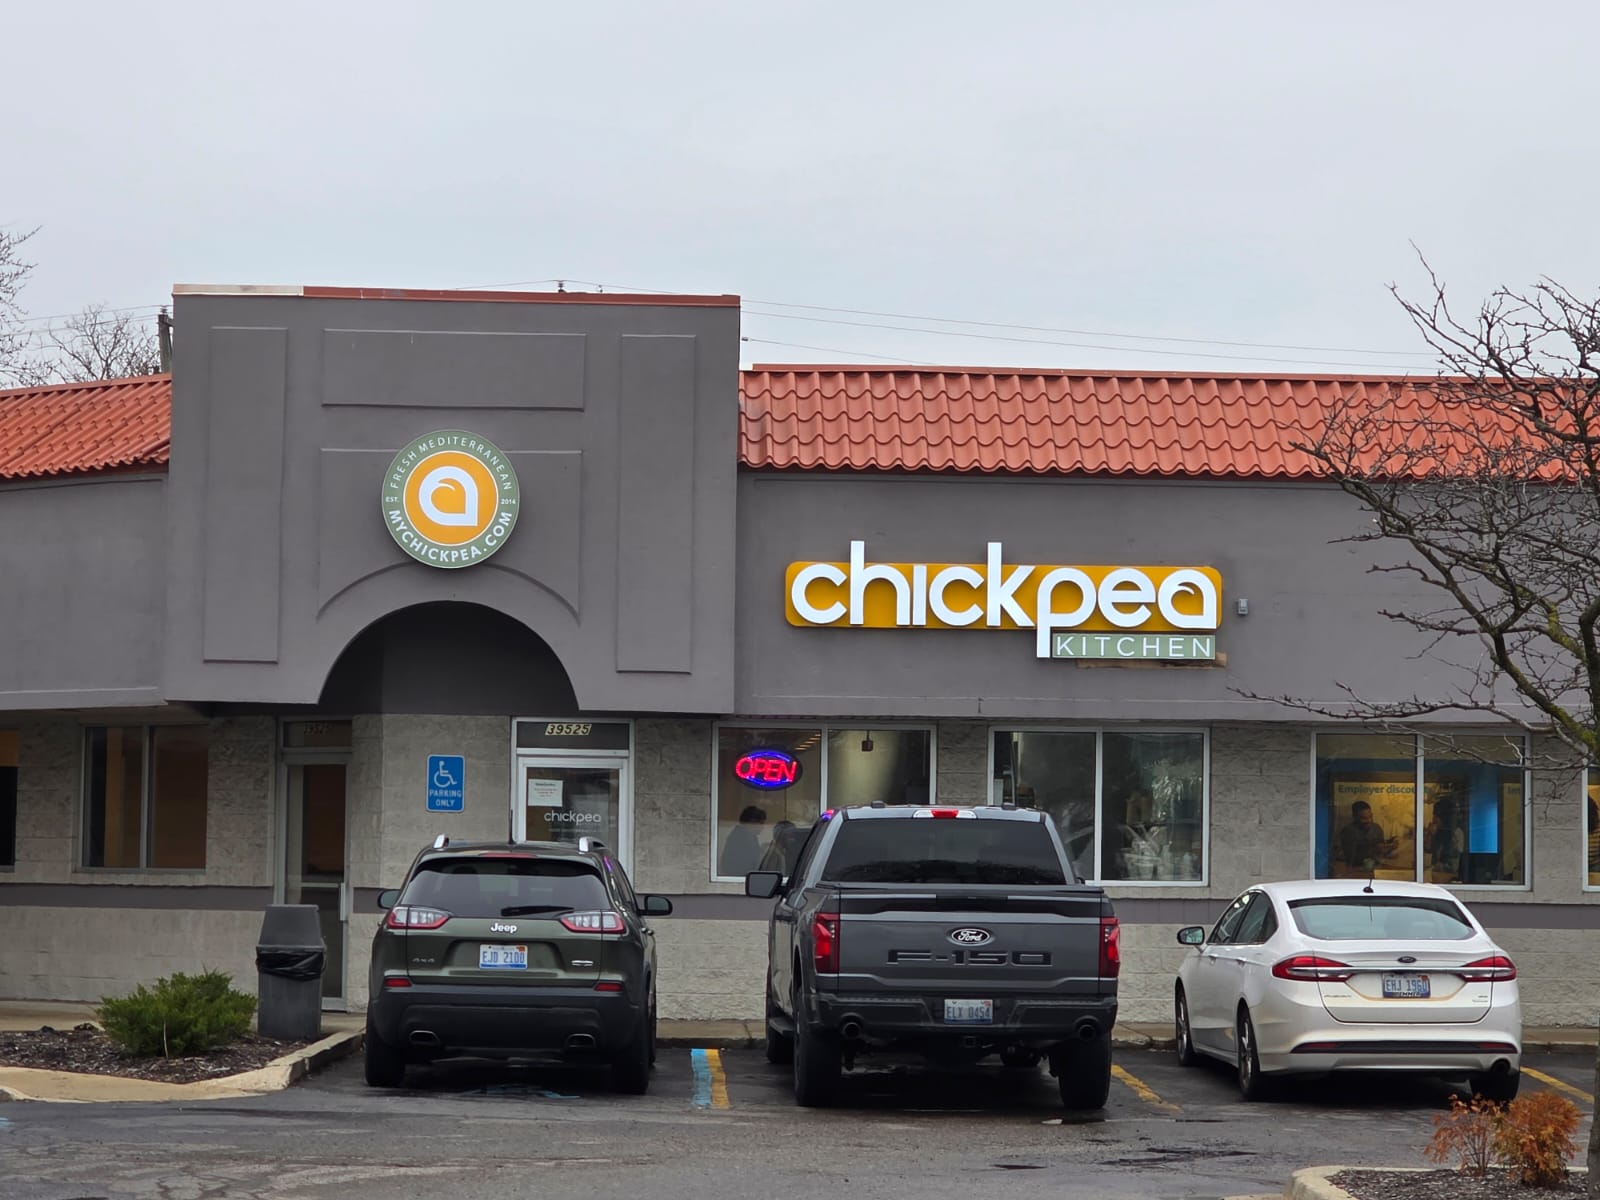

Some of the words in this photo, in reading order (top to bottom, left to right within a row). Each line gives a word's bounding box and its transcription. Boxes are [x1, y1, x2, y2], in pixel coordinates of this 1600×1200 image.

[390, 451, 417, 489] FRESH
[418, 436, 512, 490] MEDITERRANEAN
[389, 510, 513, 563] MYCHICKPEA.COM
[791, 540, 1217, 658] chickpea
[1056, 635, 1212, 658] KITCHEN
[547, 724, 590, 735] 39525
[736, 757, 798, 782] OPEN
[429, 789, 462, 798] PARKING
[1338, 784, 1385, 795] Employer
[435, 798, 455, 807] ONLY
[544, 809, 602, 826] chickpea
[490, 922, 518, 934] Jeep
[957, 930, 983, 941] Ford
[503, 951, 525, 964] 2100
[886, 949, 1054, 967] F-150
[947, 1006, 963, 1018] ELX
